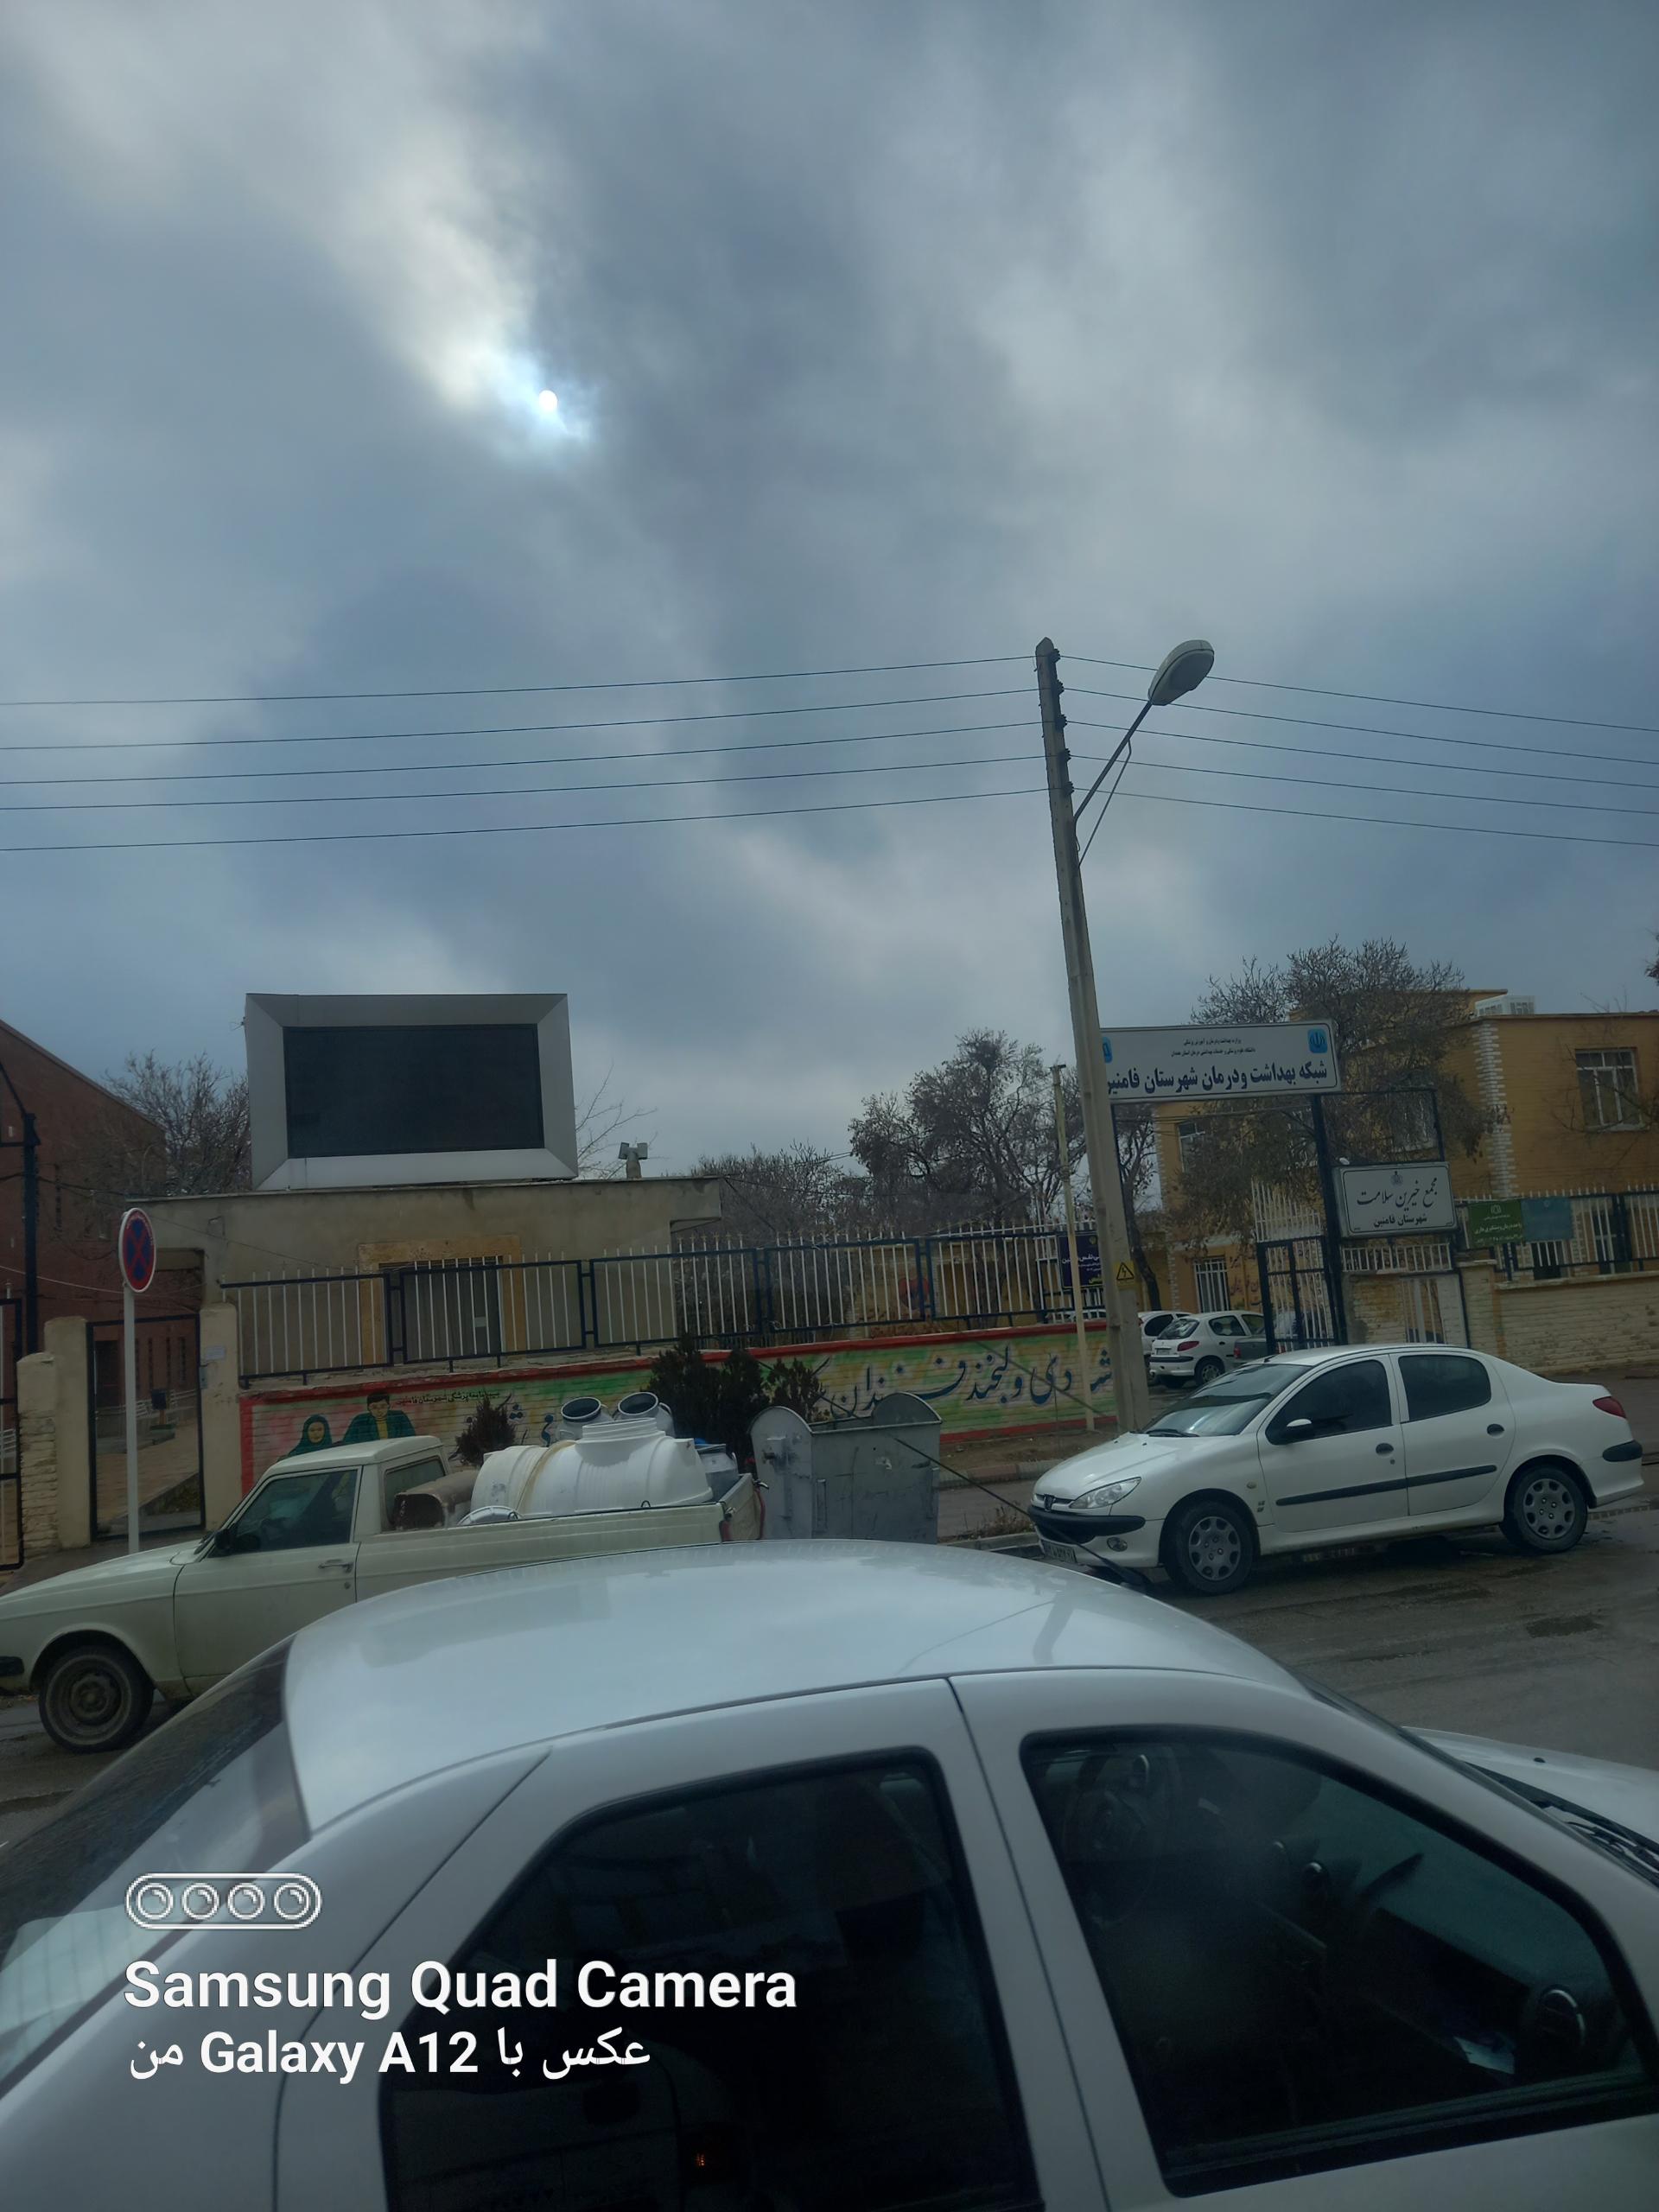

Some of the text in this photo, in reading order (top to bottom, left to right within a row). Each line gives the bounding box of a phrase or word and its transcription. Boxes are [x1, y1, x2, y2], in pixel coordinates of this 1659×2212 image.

[1108, 1065, 1140, 1095] فامنی
[1145, 1065, 1198, 1094] شهرستان
[1250, 1062, 1296, 1085] بهداشت
[1300, 1059, 1328, 1084] شبکه
[1357, 1177, 1438, 1211] مجمع خیرین سلامت
[1397, 1213, 1427, 1226] شهرستان
